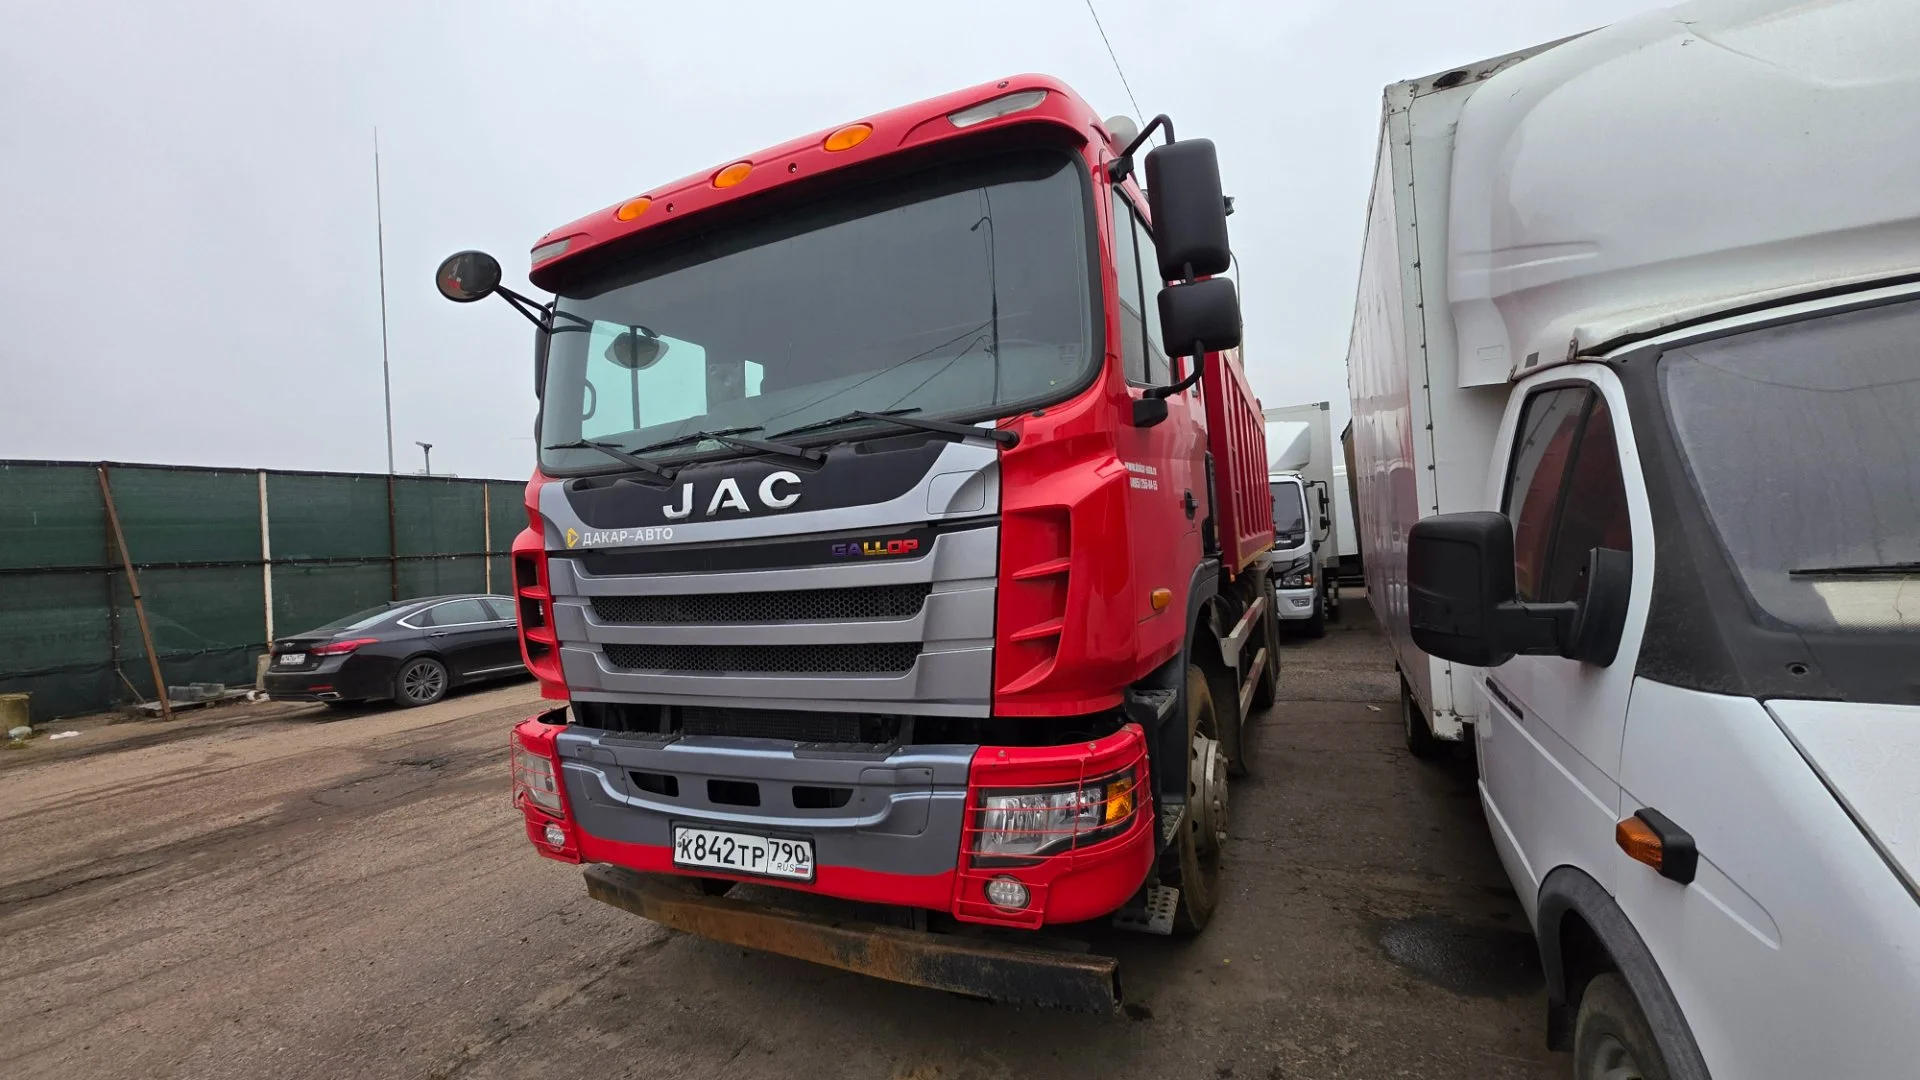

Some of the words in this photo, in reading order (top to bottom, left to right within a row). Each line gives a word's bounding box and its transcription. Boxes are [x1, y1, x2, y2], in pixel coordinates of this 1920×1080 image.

[662, 471, 802, 520] JAC
[582, 527, 674, 547] ДАКАР-АВТО
[831, 539, 919, 556] GALLOP
[680, 834, 765, 867] К842ТР
[769, 841, 806, 864] 790
[777, 862, 795, 872] RUS
